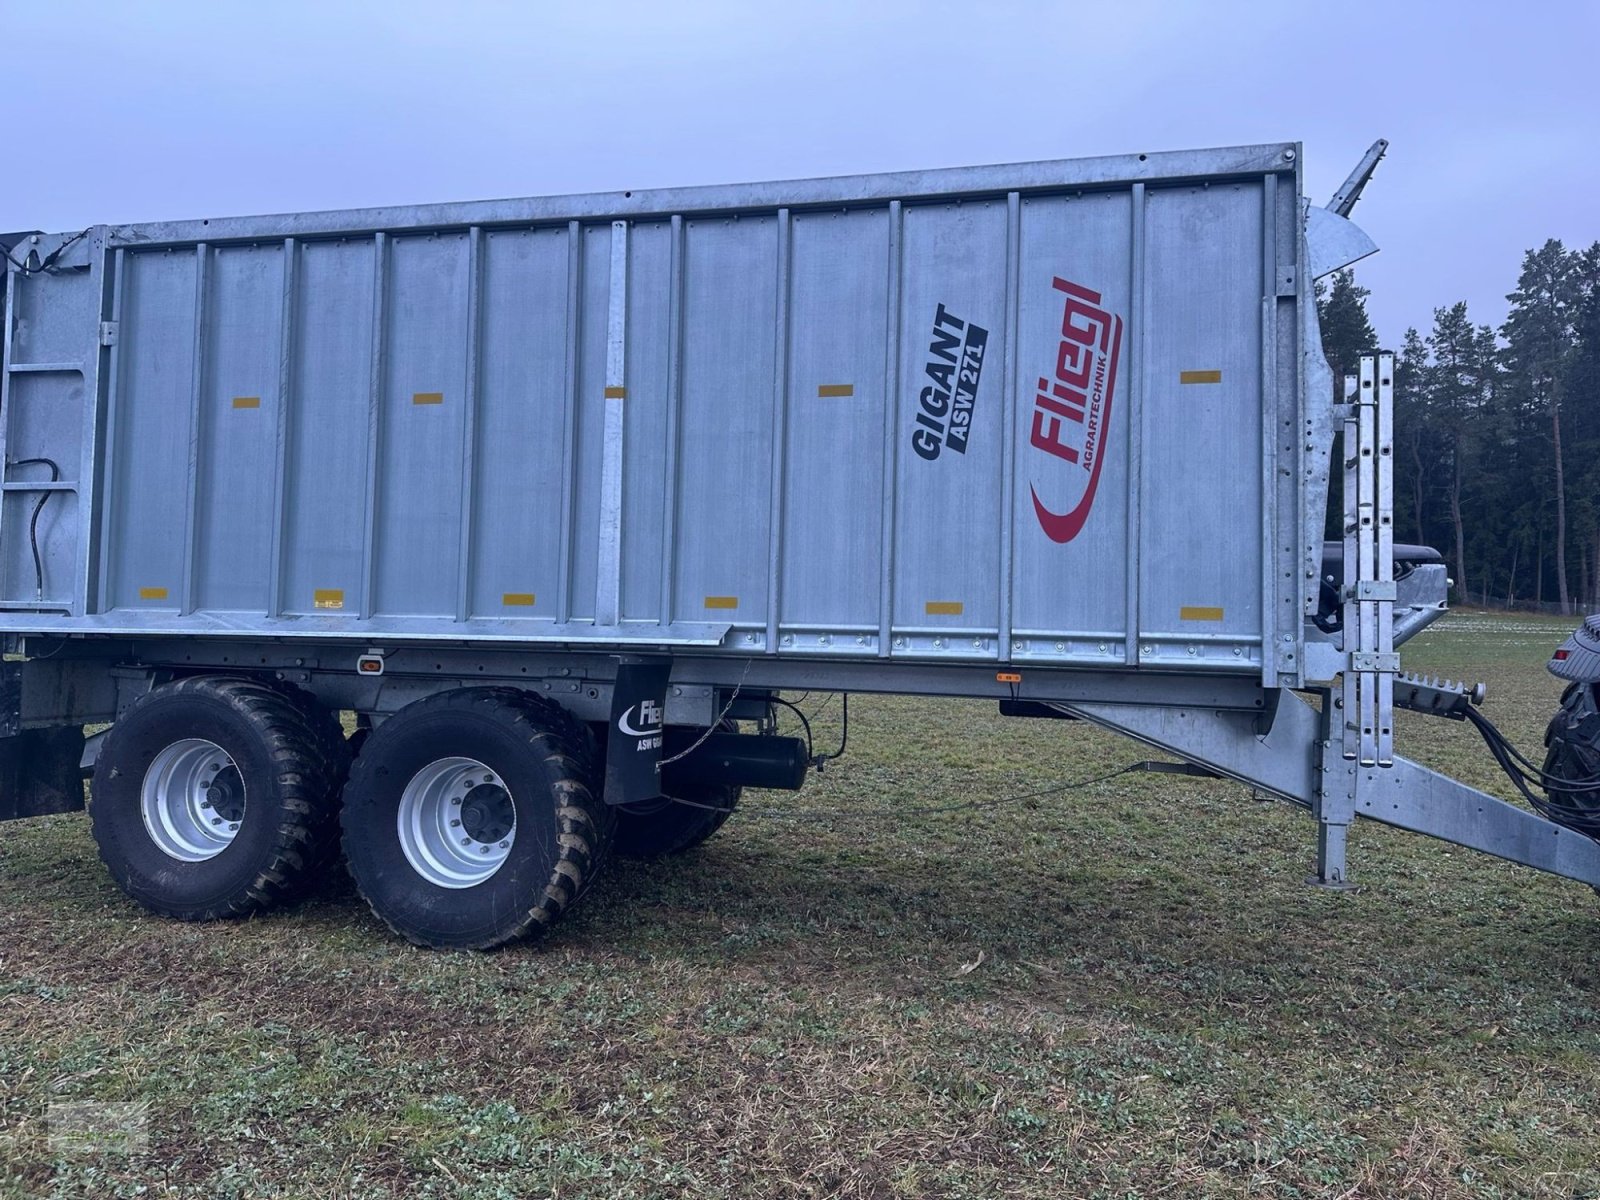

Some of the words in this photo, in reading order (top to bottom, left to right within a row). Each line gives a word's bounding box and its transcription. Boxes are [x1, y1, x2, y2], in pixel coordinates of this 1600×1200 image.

[911, 302, 965, 461] GIGANT
[960, 345, 983, 385] 271
[1030, 276, 1112, 465] Fliegl
[949, 387, 974, 441] ASW
[1082, 356, 1106, 472] AGRARTECHNIK
[639, 700, 662, 727] Flie
[637, 739, 652, 751] ASW
